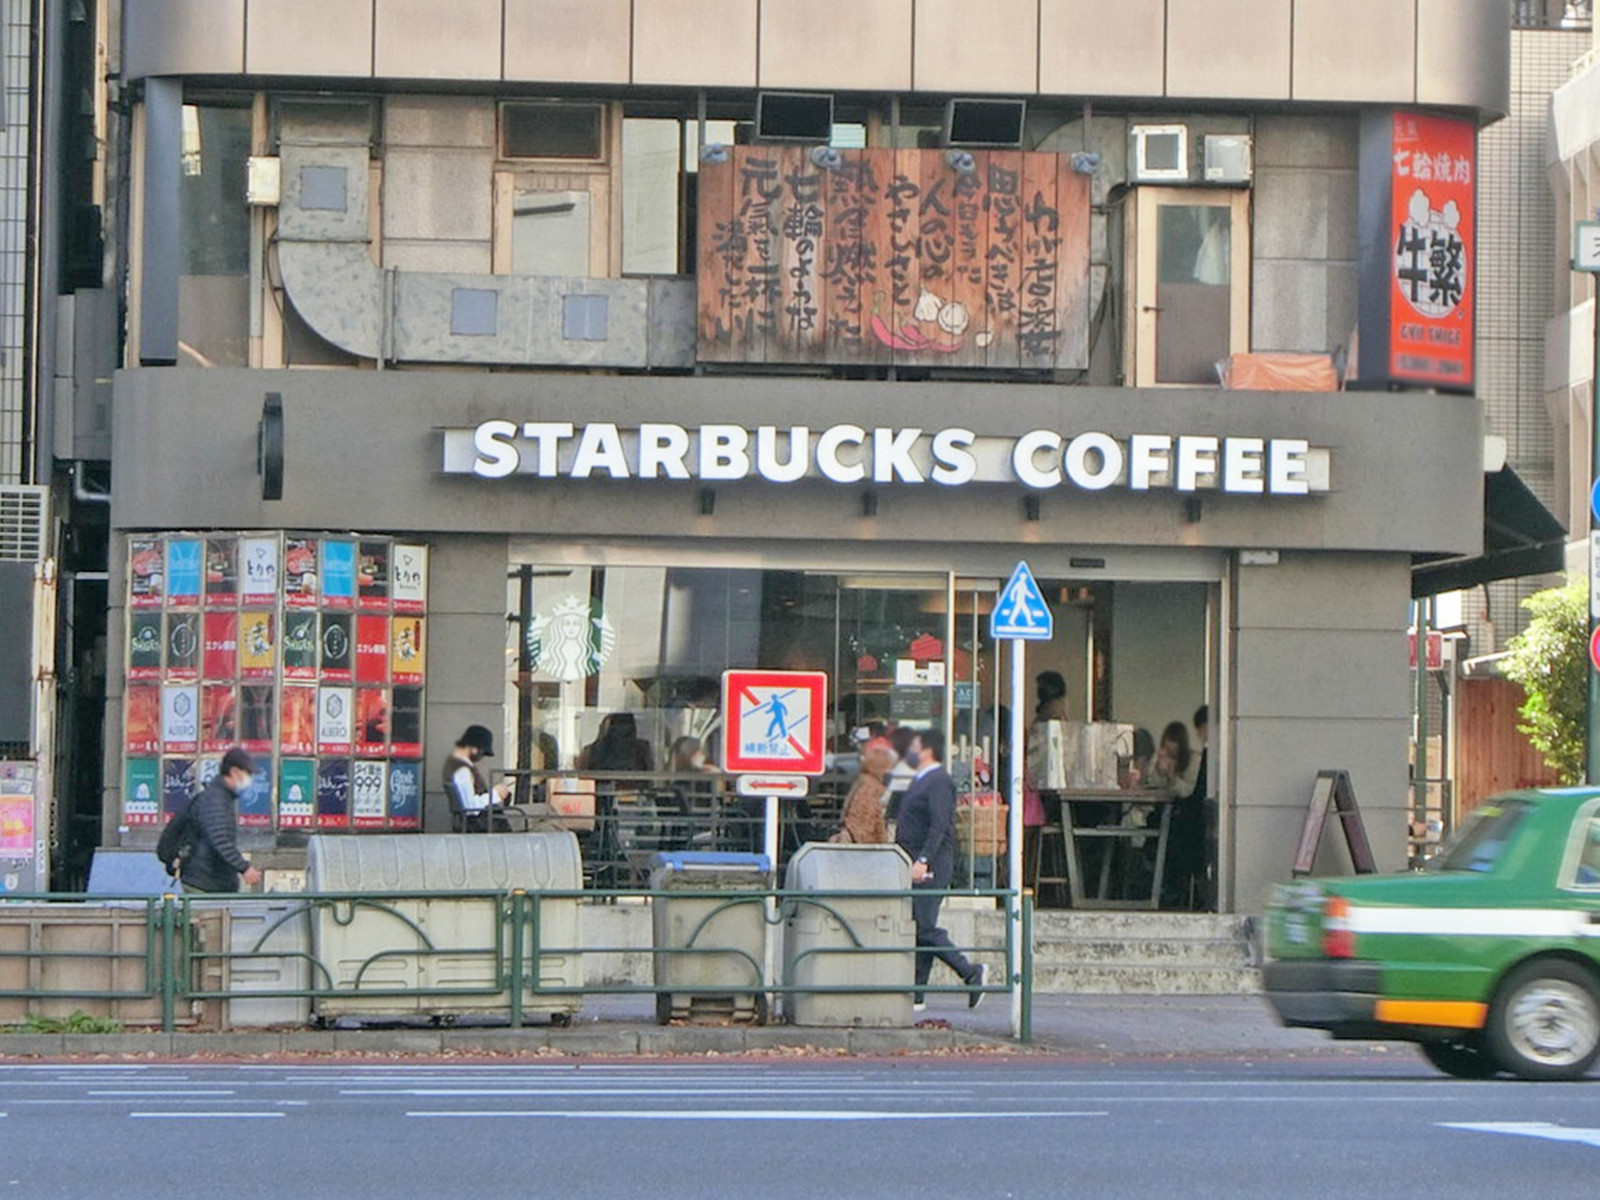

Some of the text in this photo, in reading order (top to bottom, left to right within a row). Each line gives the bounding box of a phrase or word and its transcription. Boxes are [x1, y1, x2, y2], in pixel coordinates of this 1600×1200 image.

[1393, 148, 1470, 185] 七輪焼肉
[782, 165, 824, 331] 七輪のような
[916, 179, 956, 282] 人の心の
[1397, 223, 1462, 307] 牛繁
[473, 419, 1310, 495] STARBUCKS COFFEE
[355, 775, 382, 793] 999
